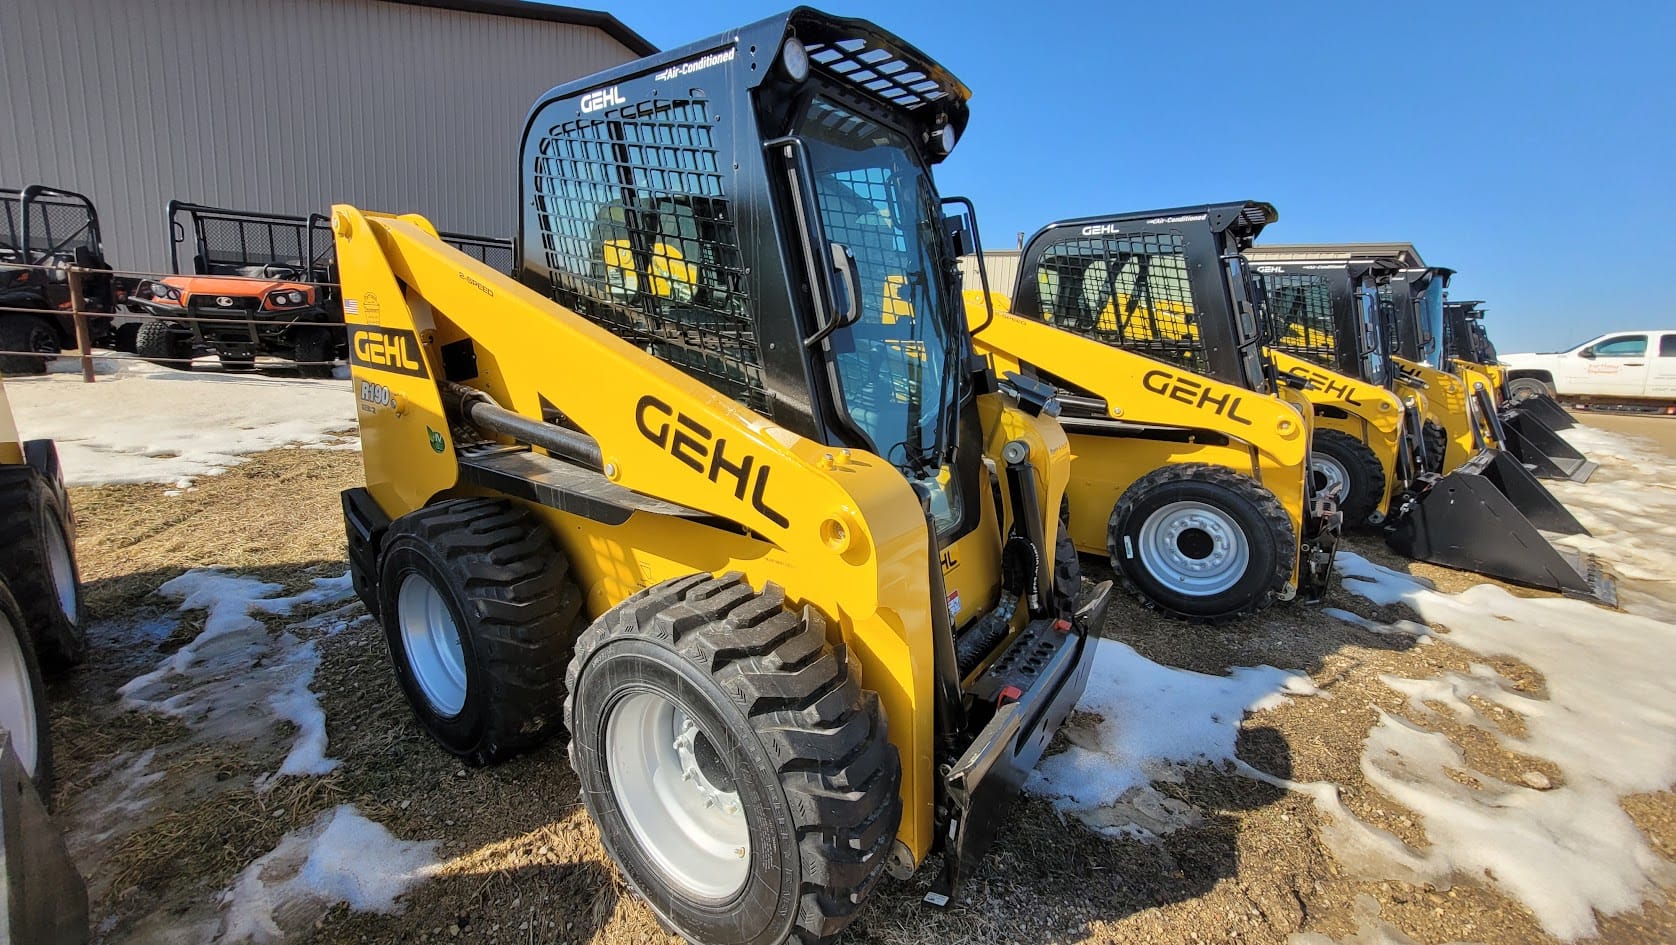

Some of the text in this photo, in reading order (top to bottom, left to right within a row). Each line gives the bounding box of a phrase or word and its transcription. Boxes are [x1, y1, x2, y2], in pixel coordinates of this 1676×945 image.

[666, 47, 735, 80] Air-Conditioned
[580, 85, 626, 114] GEHL
[1081, 224, 1120, 236] GEHL
[1256, 265, 1285, 273] GEHL
[458, 271, 494, 297] 2-SPEED
[354, 330, 419, 371] GEHL
[361, 380, 390, 406] R190
[1142, 369, 1253, 426] GEHL
[635, 394, 790, 530] GEHL
